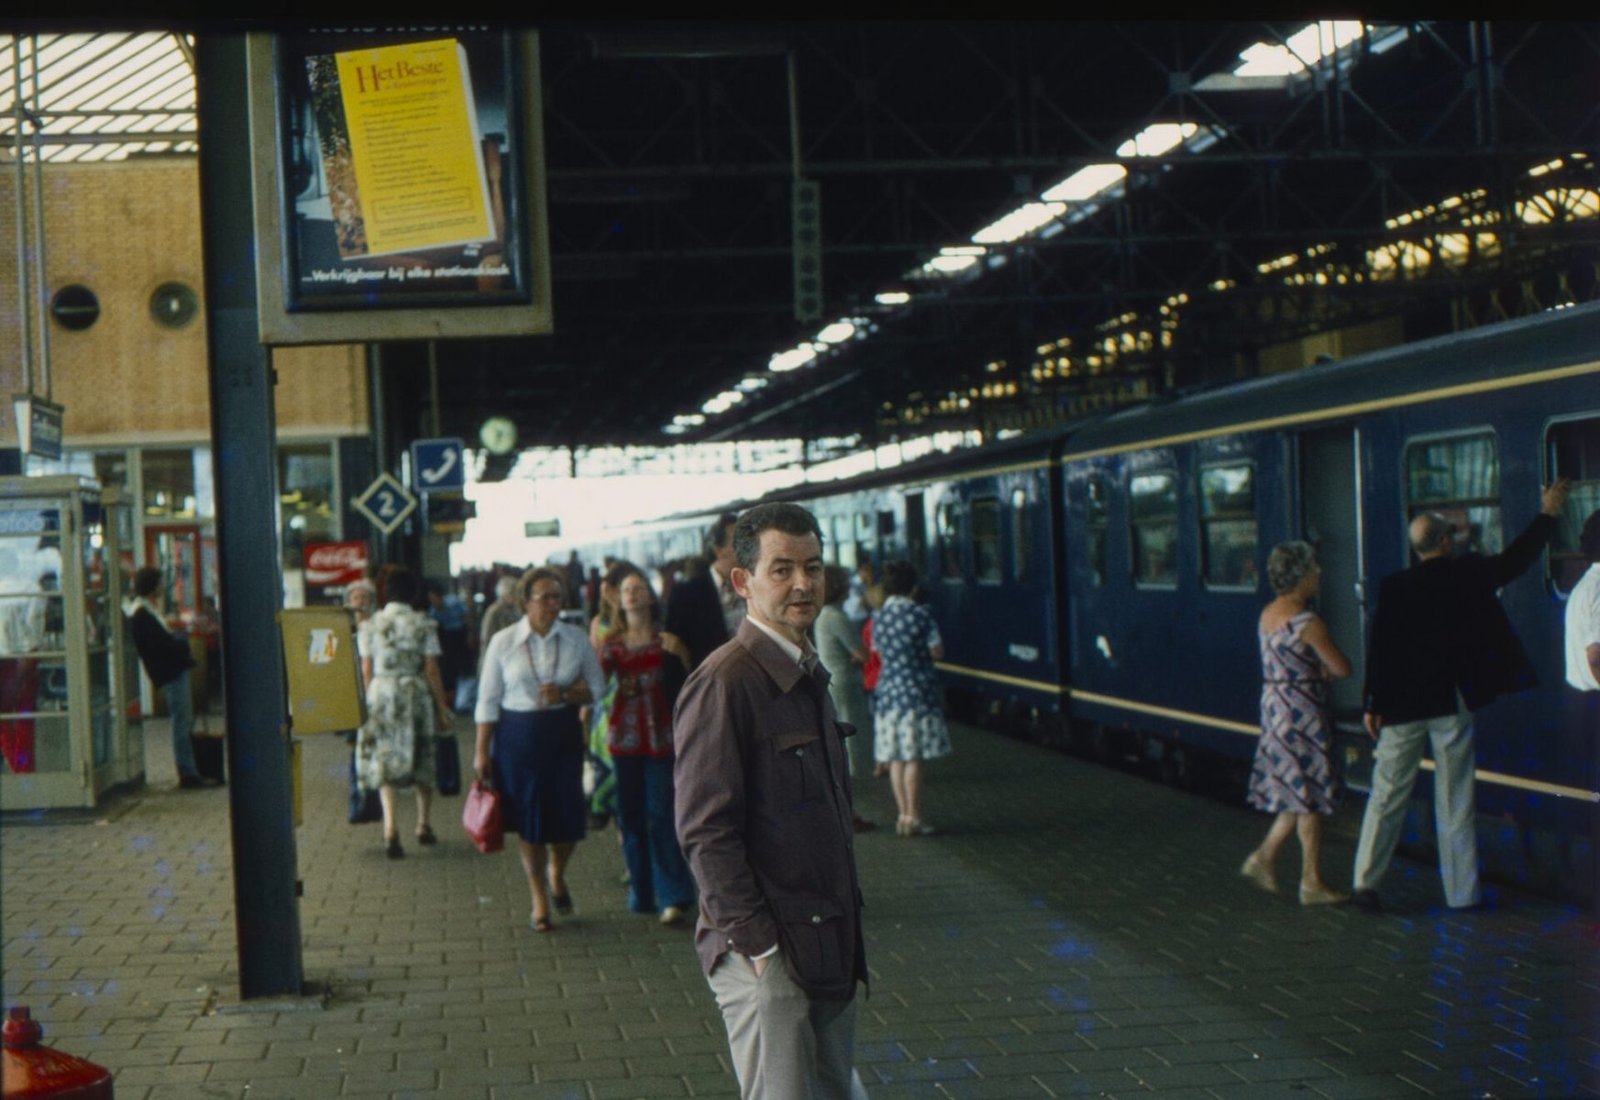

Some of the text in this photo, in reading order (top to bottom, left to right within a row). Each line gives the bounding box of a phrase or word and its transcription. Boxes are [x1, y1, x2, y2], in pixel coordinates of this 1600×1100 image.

[356, 64, 394, 94] Het
[396, 61, 443, 79] Beste
[388, 266, 405, 281] bij
[407, 267, 431, 279] elke
[378, 491, 396, 517] 2
